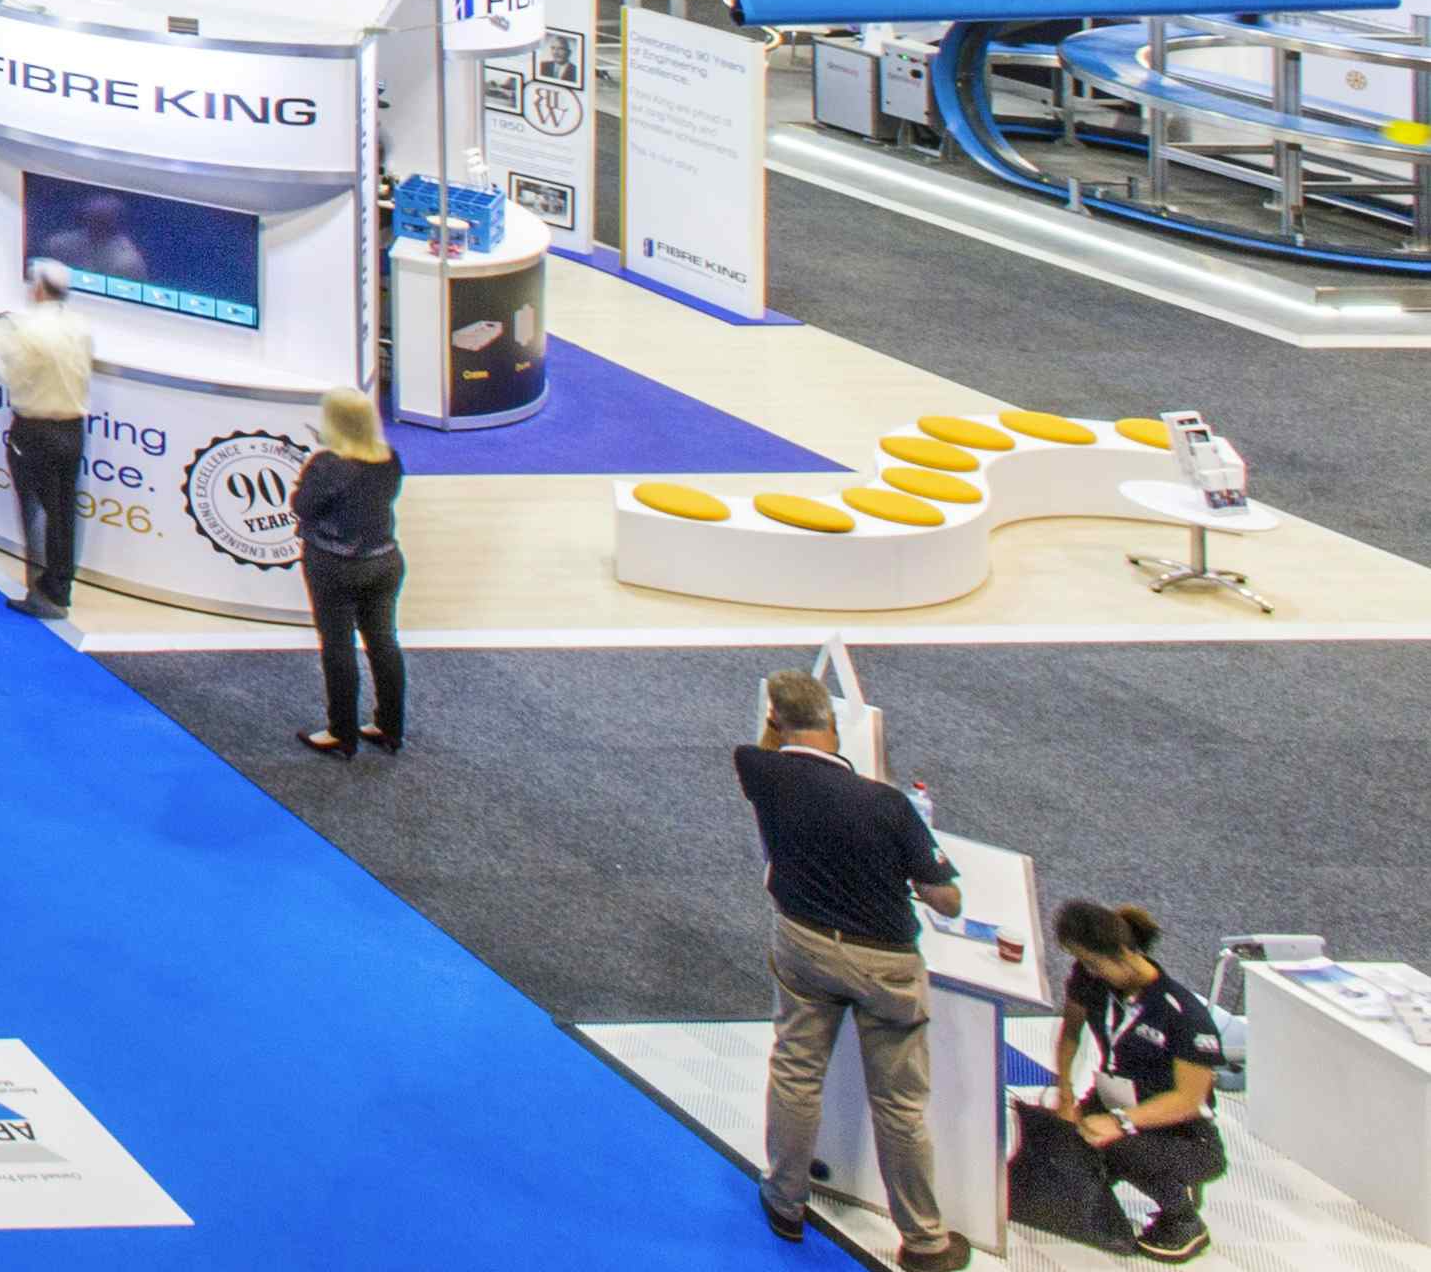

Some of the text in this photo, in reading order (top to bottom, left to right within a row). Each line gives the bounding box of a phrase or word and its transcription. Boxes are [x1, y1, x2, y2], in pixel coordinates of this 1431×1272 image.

[154, 84, 318, 129] KING
[656, 240, 748, 286] FIBRE KING
[227, 467, 286, 514] 90
[243, 511, 300, 533] YEARS
